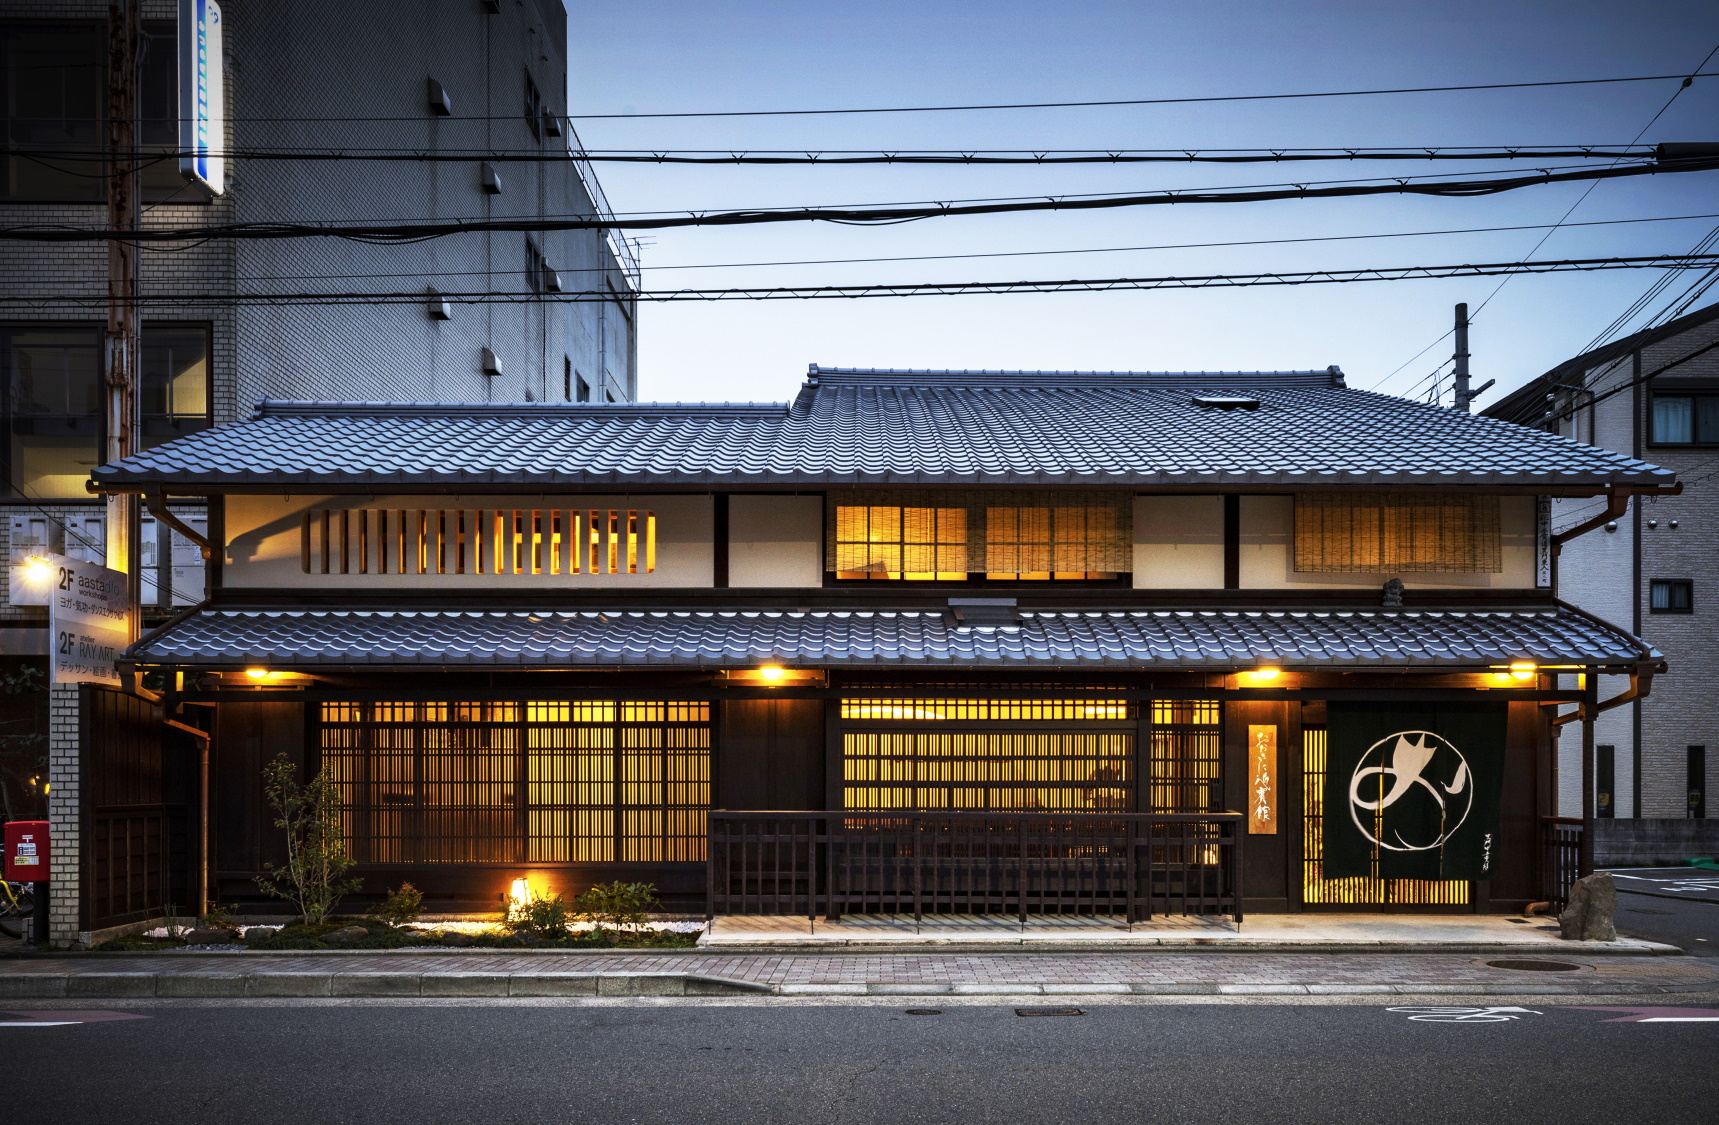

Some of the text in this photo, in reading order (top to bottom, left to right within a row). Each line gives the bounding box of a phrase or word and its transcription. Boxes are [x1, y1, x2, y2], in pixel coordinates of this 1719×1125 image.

[59, 566, 75, 591] 2F
[79, 589, 108, 602] workshops
[60, 631, 75, 655] 2F
[80, 635, 95, 643] atelier
[80, 641, 115, 662] RAY ART
